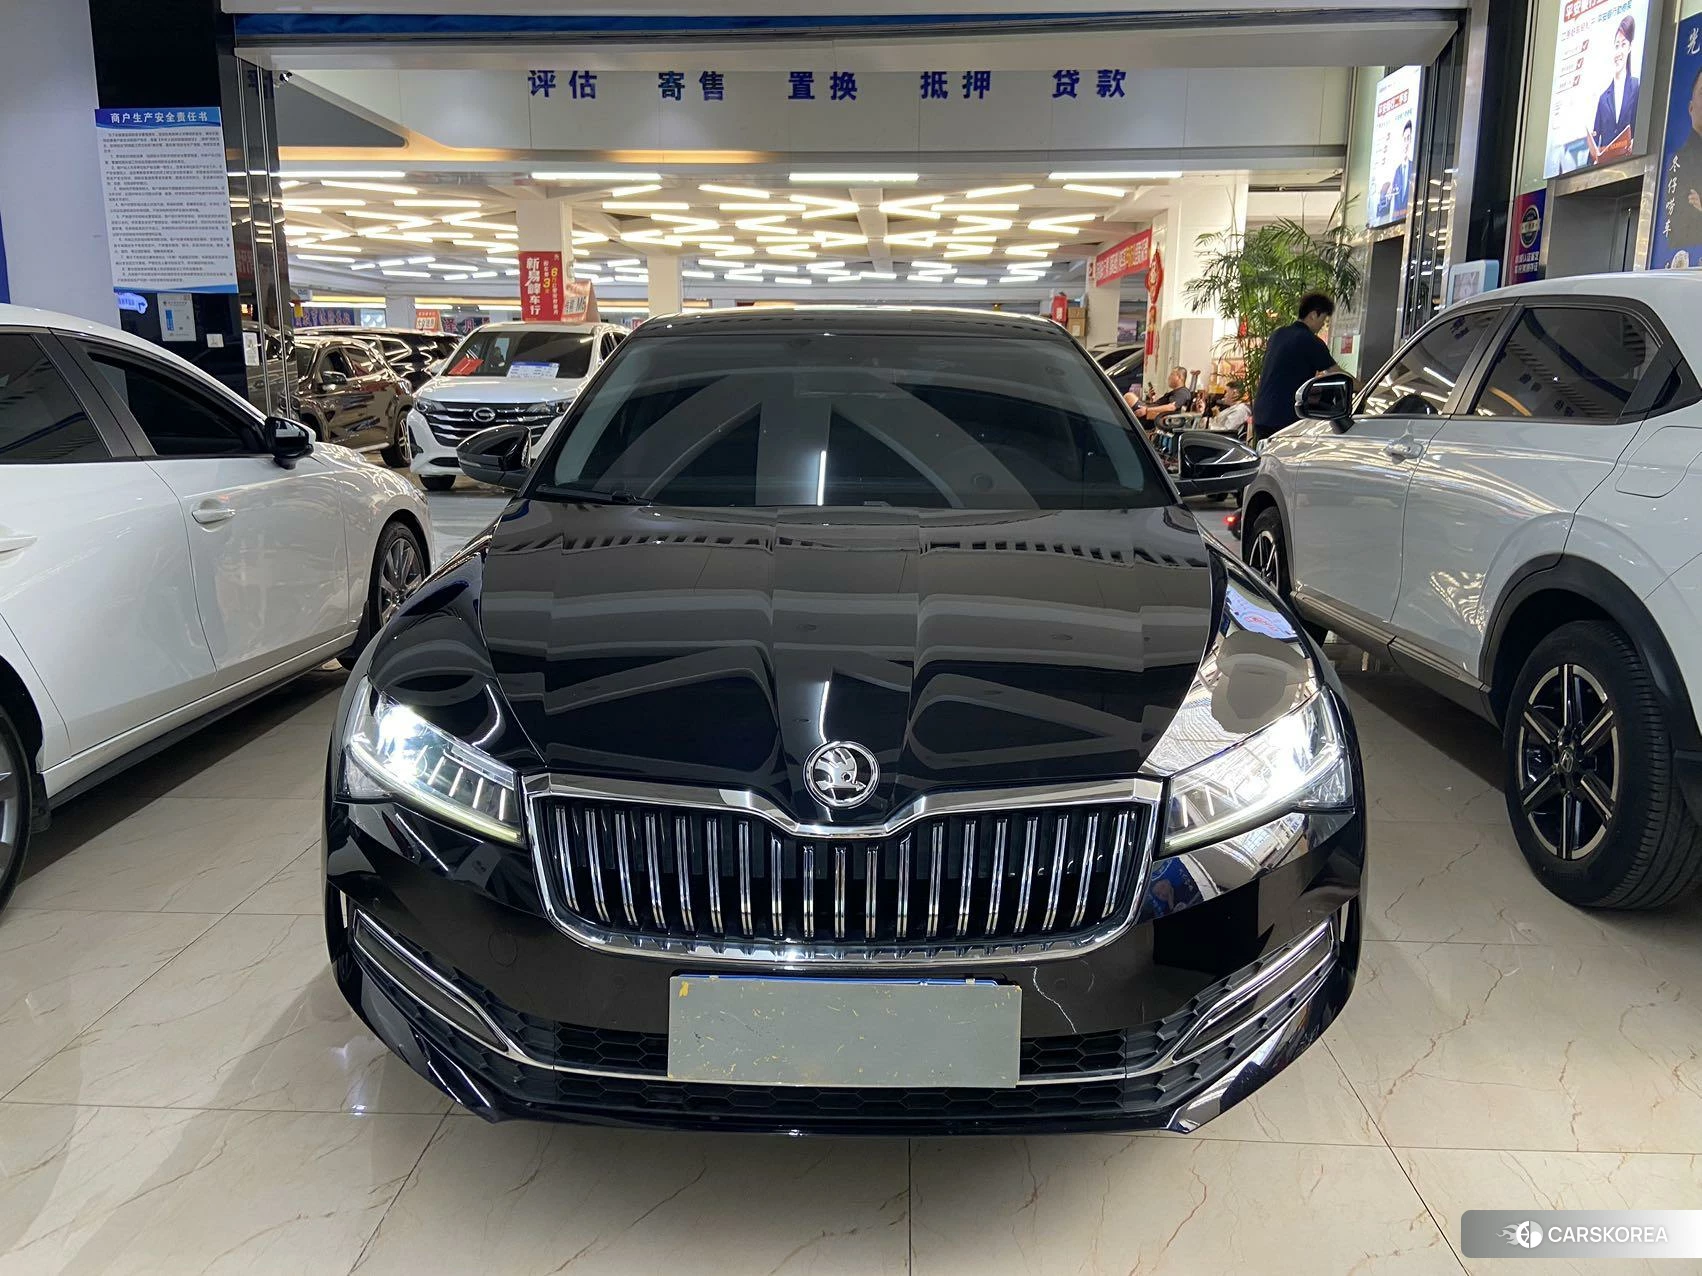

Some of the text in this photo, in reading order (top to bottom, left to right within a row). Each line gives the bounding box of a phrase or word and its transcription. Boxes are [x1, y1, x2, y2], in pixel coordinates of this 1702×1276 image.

[528, 69, 1127, 101] 评估 寄售 置换 抵押 贷款
[110, 111, 208, 124] 商户生产安全责任书
